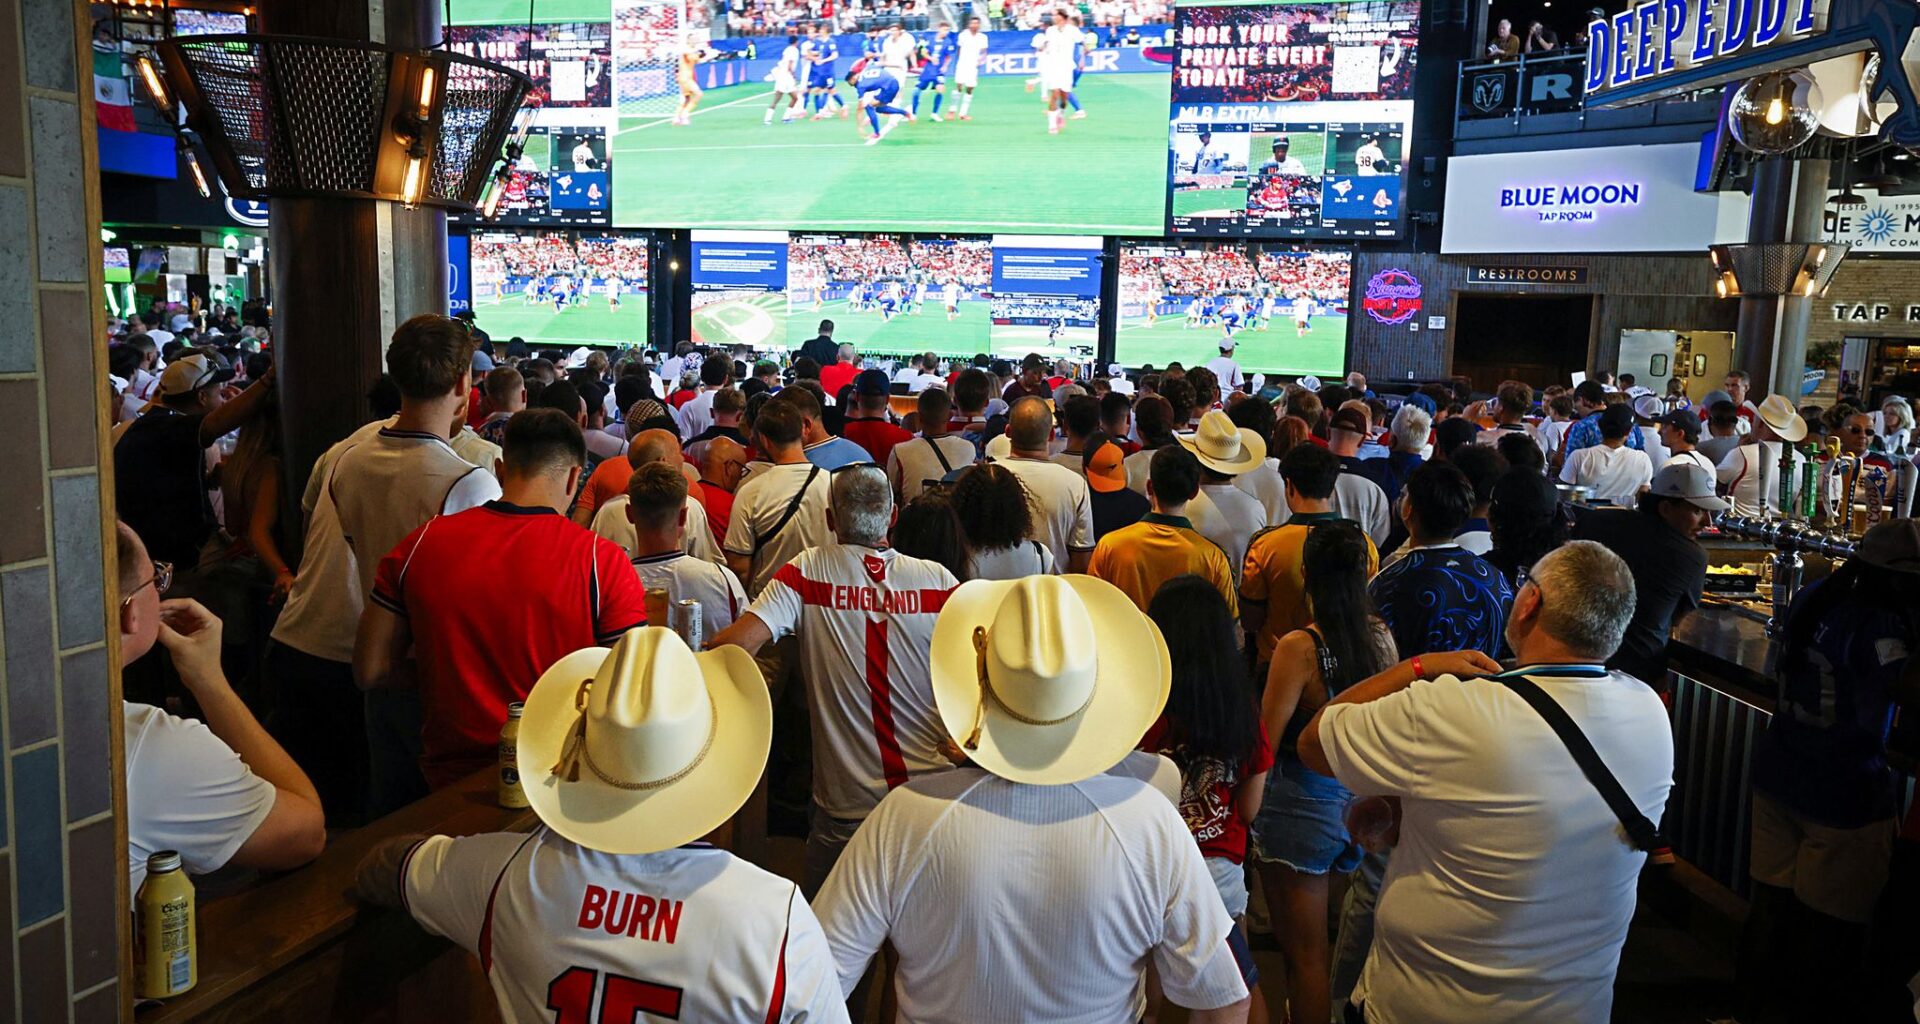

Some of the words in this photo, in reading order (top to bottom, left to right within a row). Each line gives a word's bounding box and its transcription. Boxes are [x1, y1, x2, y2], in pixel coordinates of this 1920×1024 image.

[1182, 26, 1232, 45] BOOK
[1240, 25, 1288, 43] YOUR
[1181, 47, 1259, 66] PRIVATE
[1266, 46, 1326, 65] EVENT
[1585, 0, 1687, 93] DEEP
[1181, 68, 1245, 87] TODAY!
[1217, 105, 1269, 121] EXTRA
[1500, 187, 1555, 207] BLUE
[1559, 184, 1640, 205] MOON
[1538, 212, 1557, 221] TAP
[1559, 211, 1593, 221] ROOM
[1841, 203, 1868, 211] ESTD
[1478, 268, 1577, 281] RESTROOMS
[1834, 304, 1890, 321] TAP
[834, 585, 919, 614] ENGLAND
[577, 884, 683, 944] BURN
